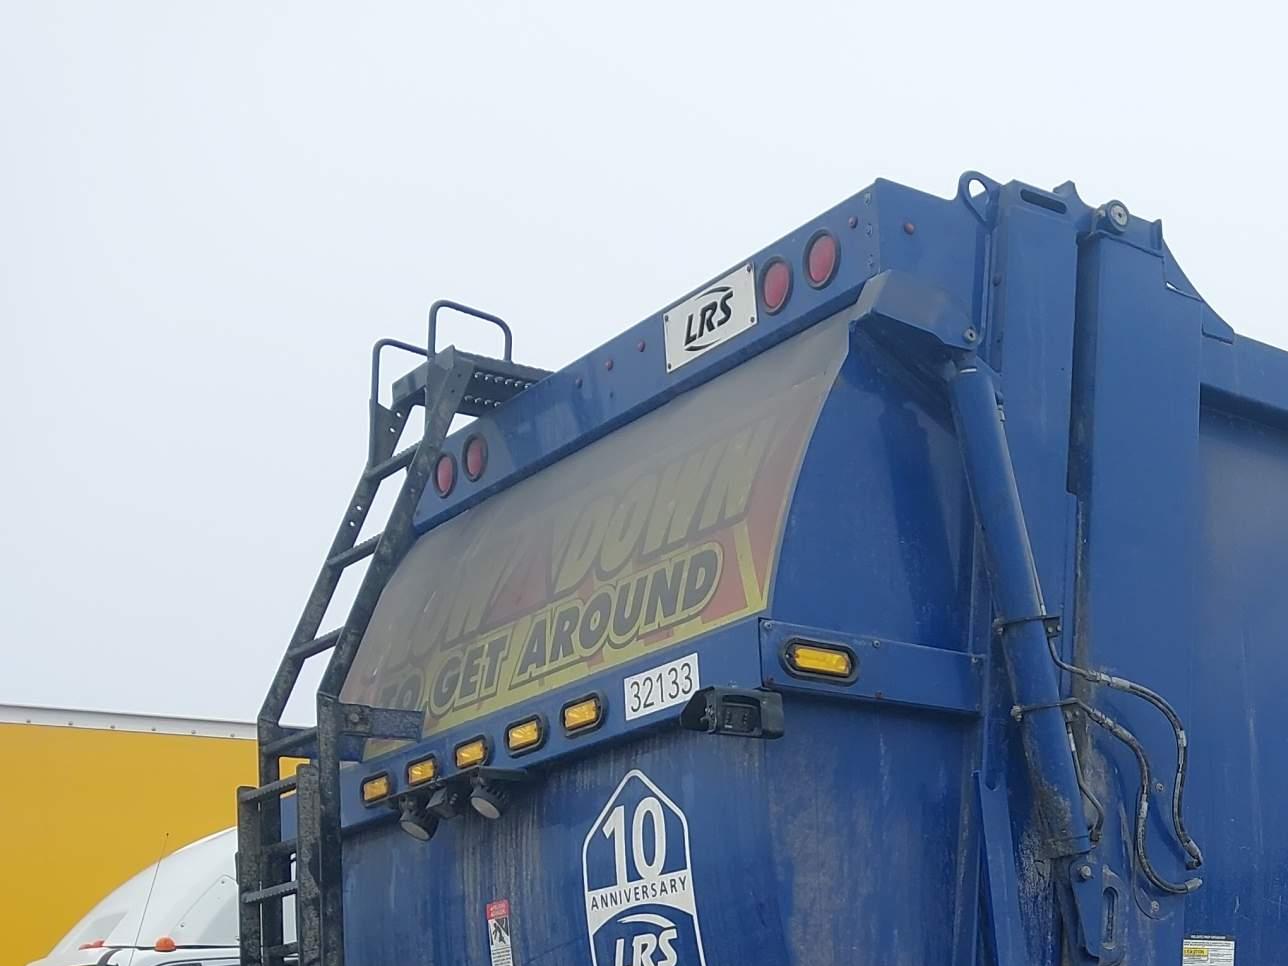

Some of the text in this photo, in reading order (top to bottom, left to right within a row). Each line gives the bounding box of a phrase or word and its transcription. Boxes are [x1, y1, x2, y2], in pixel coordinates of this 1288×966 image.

[684, 290, 734, 347] LRS
[432, 634, 508, 709] GET
[515, 548, 718, 679] AROUND
[630, 661, 693, 713] 32133
[602, 796, 666, 885] 10
[590, 875, 688, 912] ANNIVERSARY
